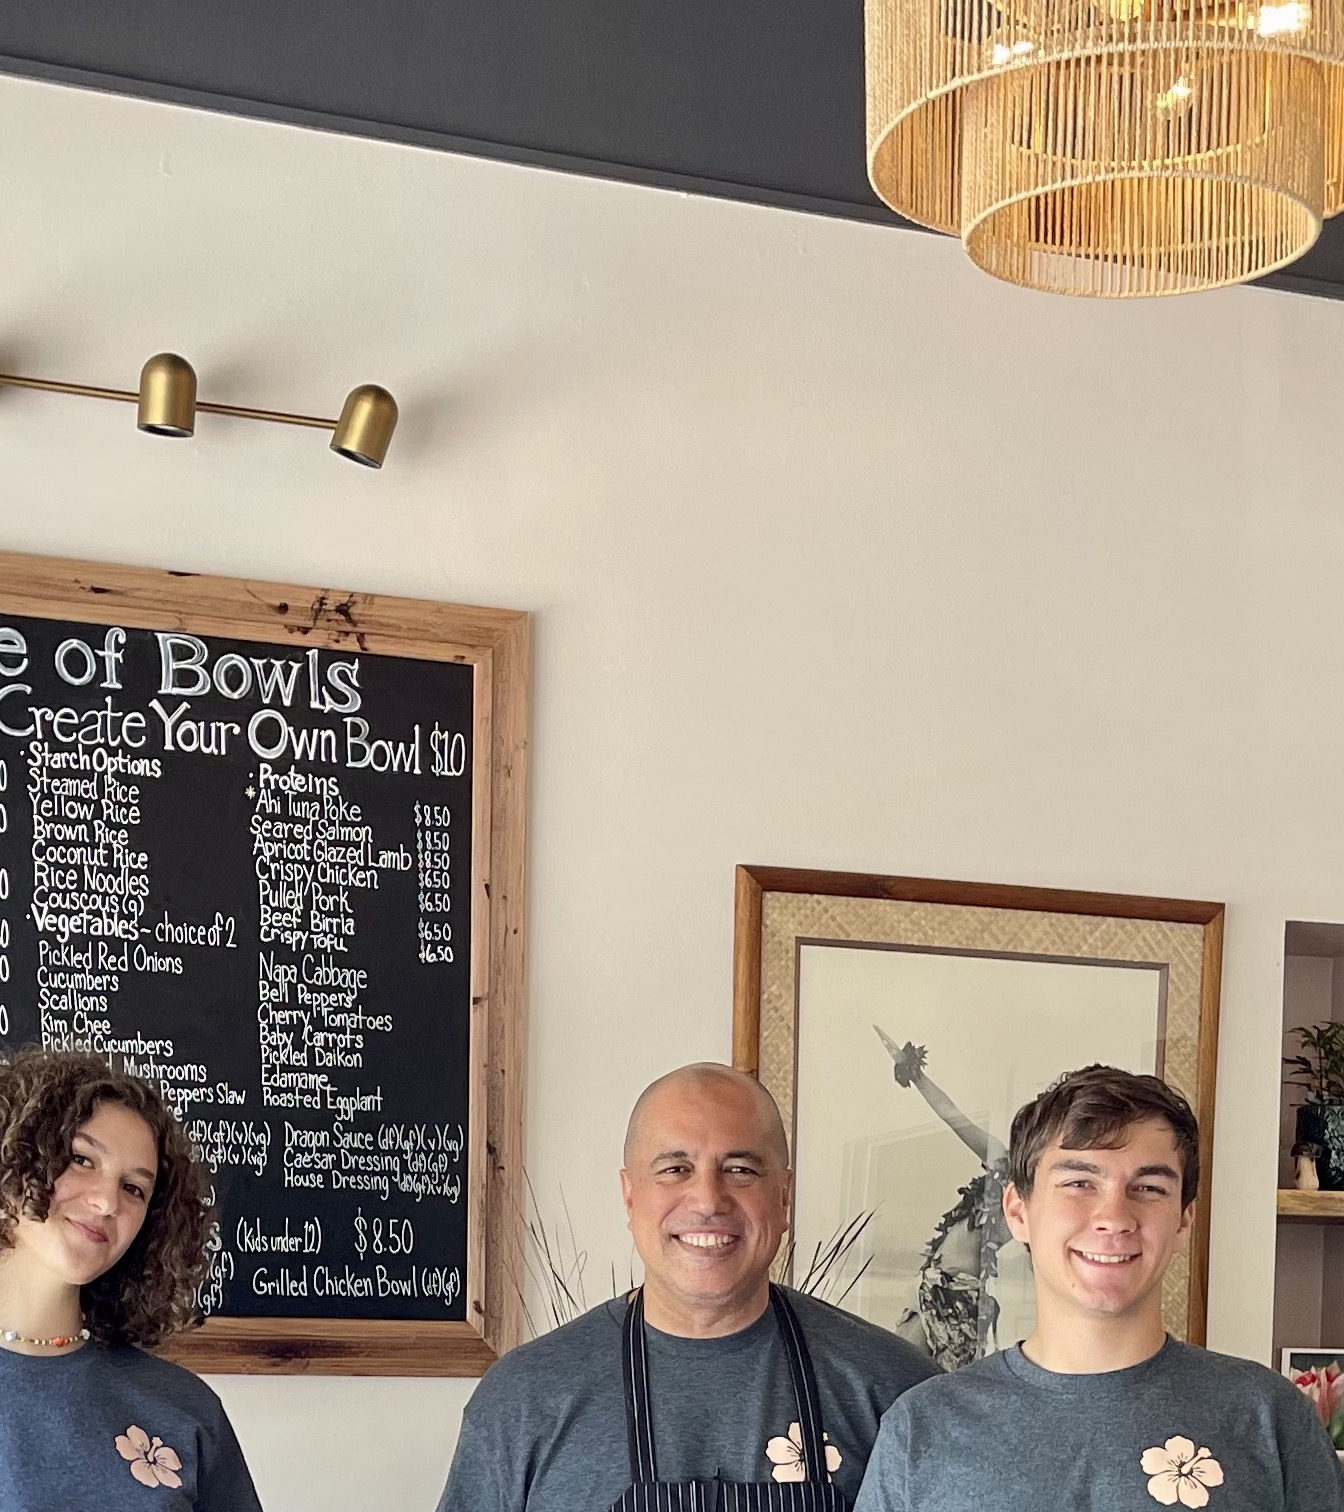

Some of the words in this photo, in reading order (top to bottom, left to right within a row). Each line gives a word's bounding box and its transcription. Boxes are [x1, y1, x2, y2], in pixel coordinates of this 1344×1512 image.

[55, 627, 127, 689] of
[155, 633, 362, 713] Bowls
[148, 699, 240, 775] Your
[248, 709, 337, 762] Own
[343, 717, 422, 774] Bowl
[431, 722, 466, 776] $10
[27, 741, 90, 772] Starch
[93, 747, 162, 780] Options
[27, 767, 98, 800] Steamed
[104, 775, 140, 805] Rice
[259, 763, 340, 796] Proteins
[29, 792, 94, 820] Yellow
[102, 800, 141, 825] Rice
[256, 790, 281, 814] Ahi
[285, 790, 320, 818] Tuna
[324, 796, 362, 822] Poke
[33, 814, 89, 842] Brown
[94, 820, 129, 845] Rice
[250, 815, 312, 840] Seared
[316, 819, 373, 842] Salmon
[32, 840, 109, 867] Coconut
[113, 842, 149, 870] Rice
[253, 834, 311, 862] Apricot
[313, 840, 364, 867] Glazed
[368, 844, 412, 871] Lamb
[33, 860, 77, 890] Rice
[84, 866, 149, 897] Noodles
[256, 855, 314, 894] Crispy
[317, 864, 379, 889] Chicken
[33, 884, 119, 913] Couscous
[259, 880, 303, 910] Pulled
[312, 882, 353, 913] Pork
[226, 917, 236, 948] 2
[260, 905, 301, 927] Beef
[311, 910, 355, 935] Birria
[260, 926, 308, 952] Crispy
[39, 940, 92, 970] Pickled
[98, 941, 129, 972] Red
[134, 944, 183, 974] Onions
[37, 966, 119, 992] Cucumbers
[259, 951, 296, 984] Napa
[302, 954, 367, 998] Cabbage
[38, 987, 108, 1012] Scallions
[259, 979, 288, 1003] Bell
[298, 983, 353, 1017] Peppers
[41, 1007, 68, 1034] Kim
[73, 1011, 111, 1035] Chee
[258, 1002, 310, 1038] Cherry
[321, 1005, 393, 1031] Tomatoes
[94, 1031, 173, 1057] Cucumbers
[259, 1025, 293, 1051] Baby
[305, 1025, 363, 1048] Carrots
[261, 1045, 307, 1067] Pickled
[316, 1047, 362, 1068] Daikon
[262, 1064, 328, 1089] Edamame
[217, 1082, 245, 1104] Slaw
[263, 1088, 320, 1109] Roasted
[327, 1085, 383, 1121] Eggplant
[284, 1121, 329, 1154] Dragon
[333, 1122, 373, 1150] Sauce
[341, 1152, 400, 1182] Dressing
[284, 1168, 324, 1188] House
[332, 1170, 389, 1200] Dressing
[253, 1266, 307, 1297] Grilled
[314, 1265, 373, 1296] Chicken
[376, 1265, 417, 1297] Bowl
